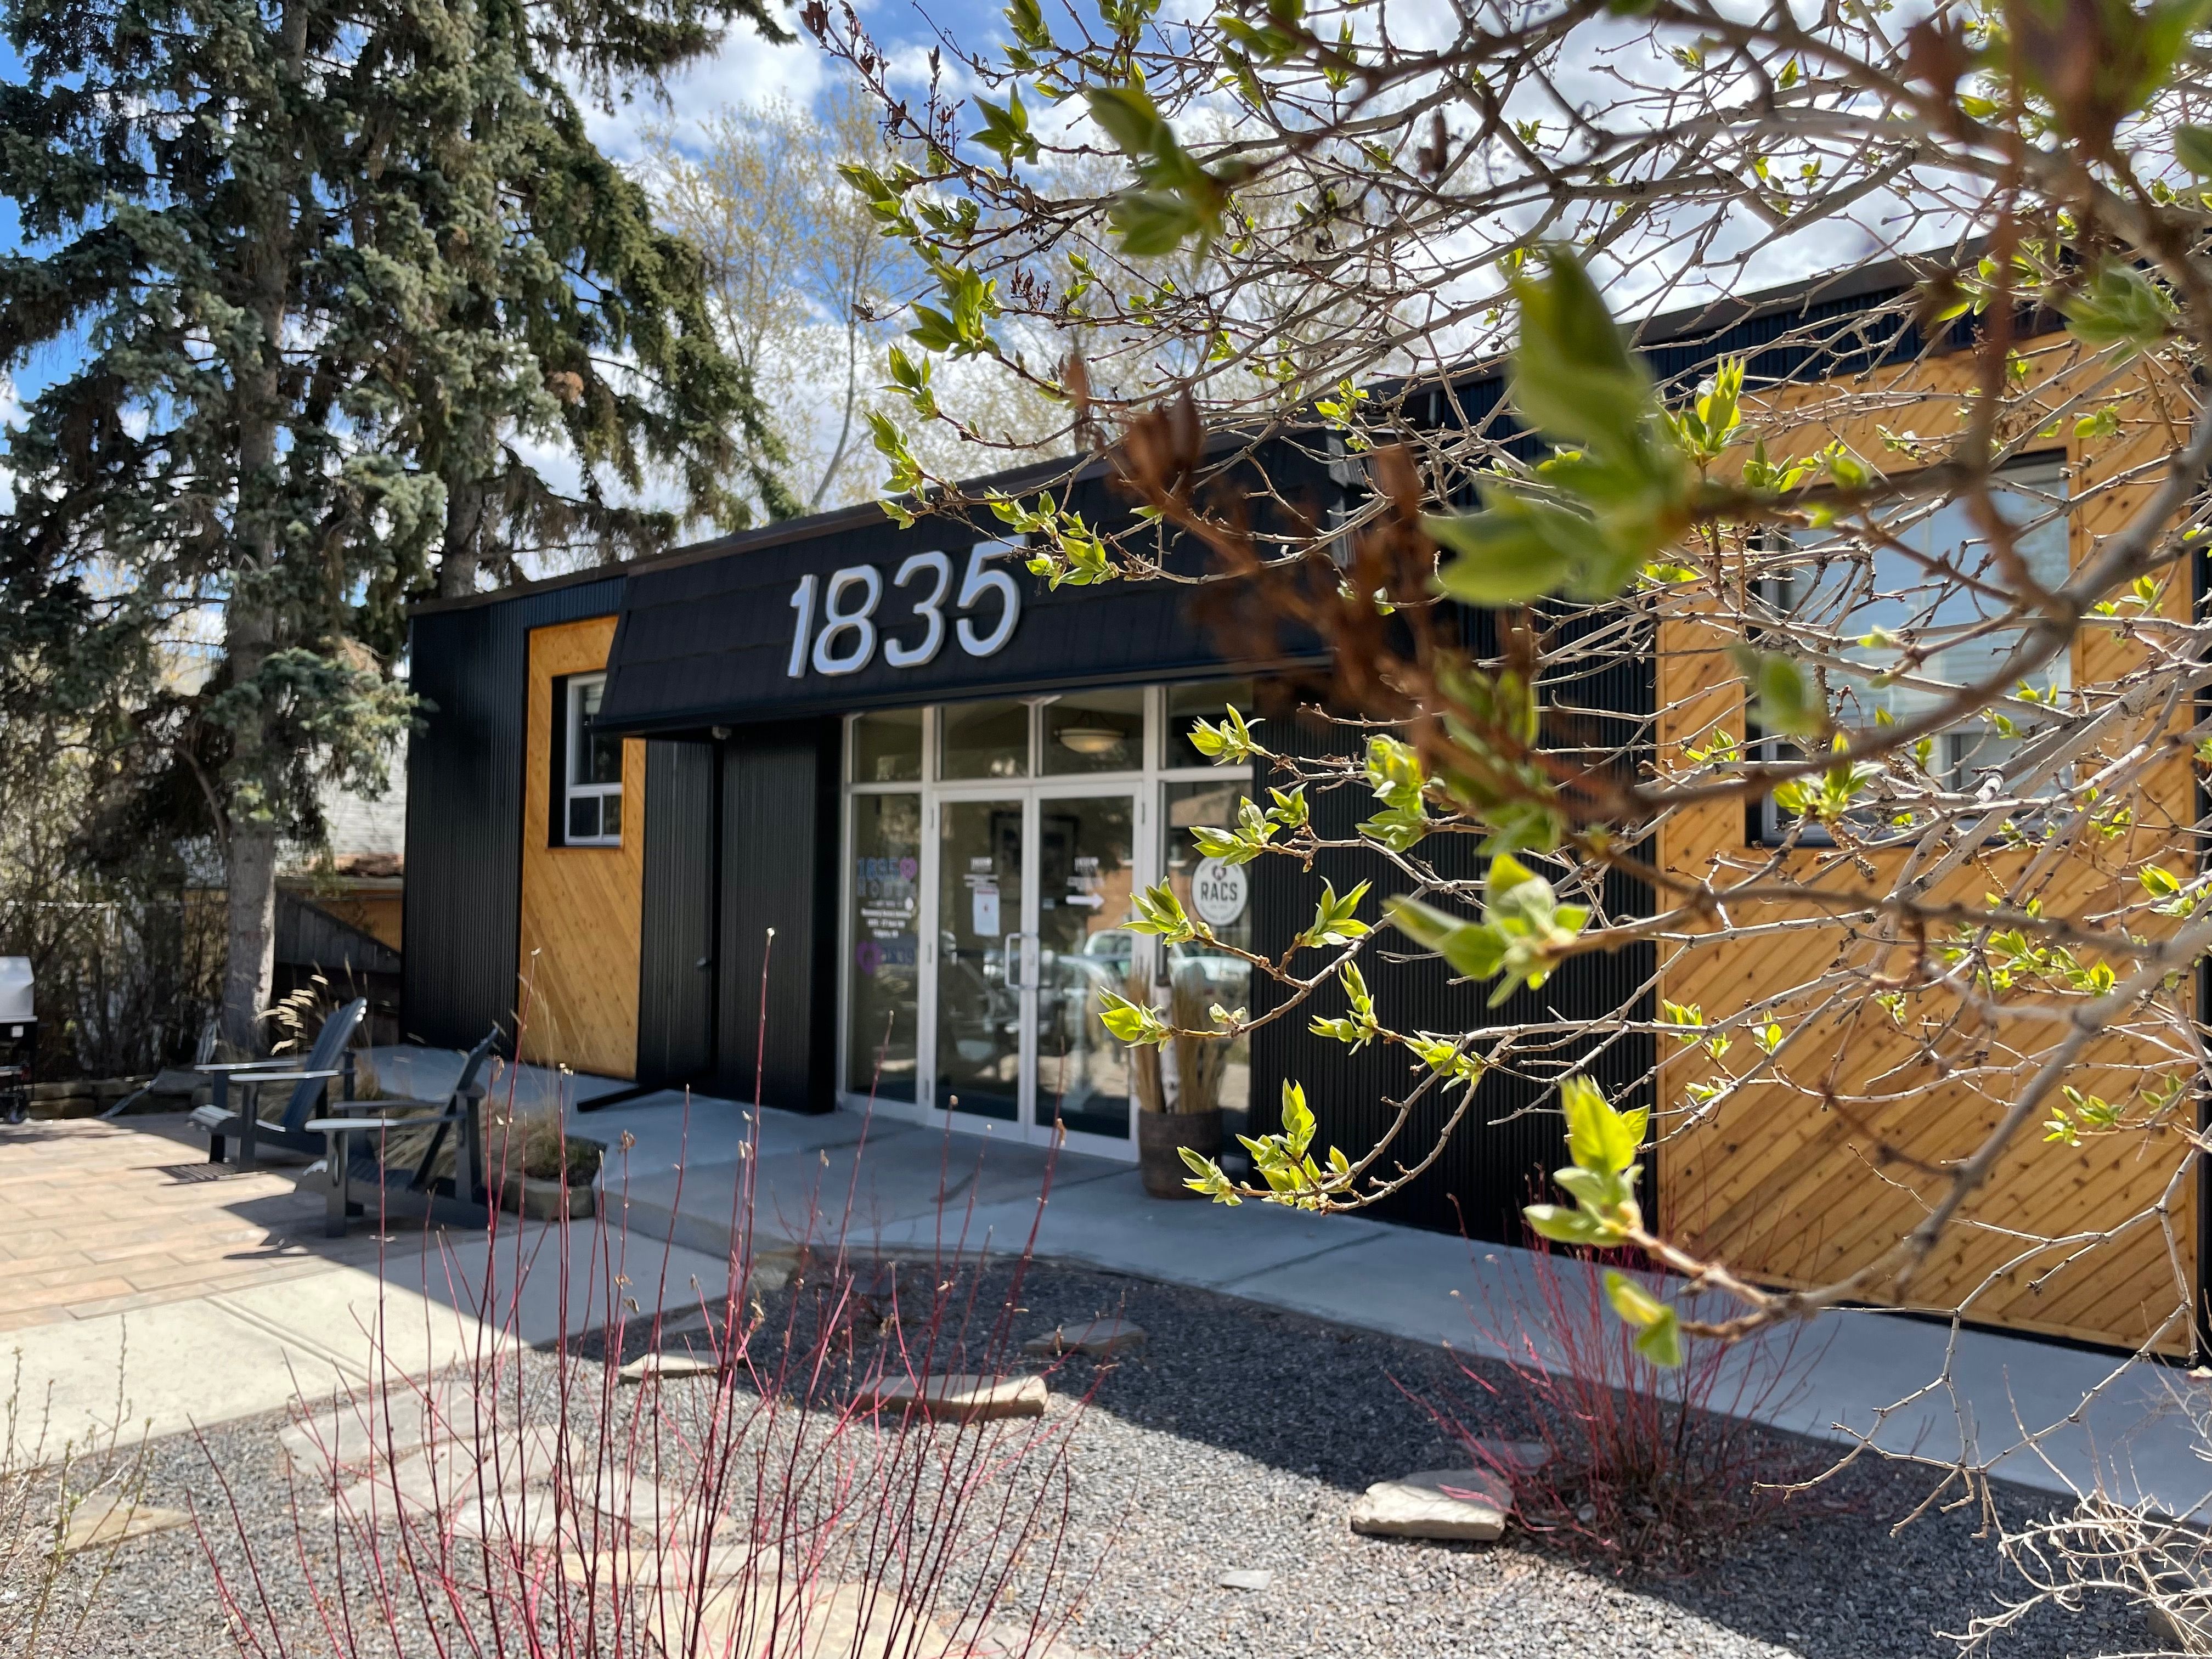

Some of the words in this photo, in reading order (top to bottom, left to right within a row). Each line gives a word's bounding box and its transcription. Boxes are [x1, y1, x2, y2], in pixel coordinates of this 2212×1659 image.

[787, 534, 1030, 678] 1835
[857, 857, 899, 881] 1835
[1200, 882, 1238, 901] RACS
